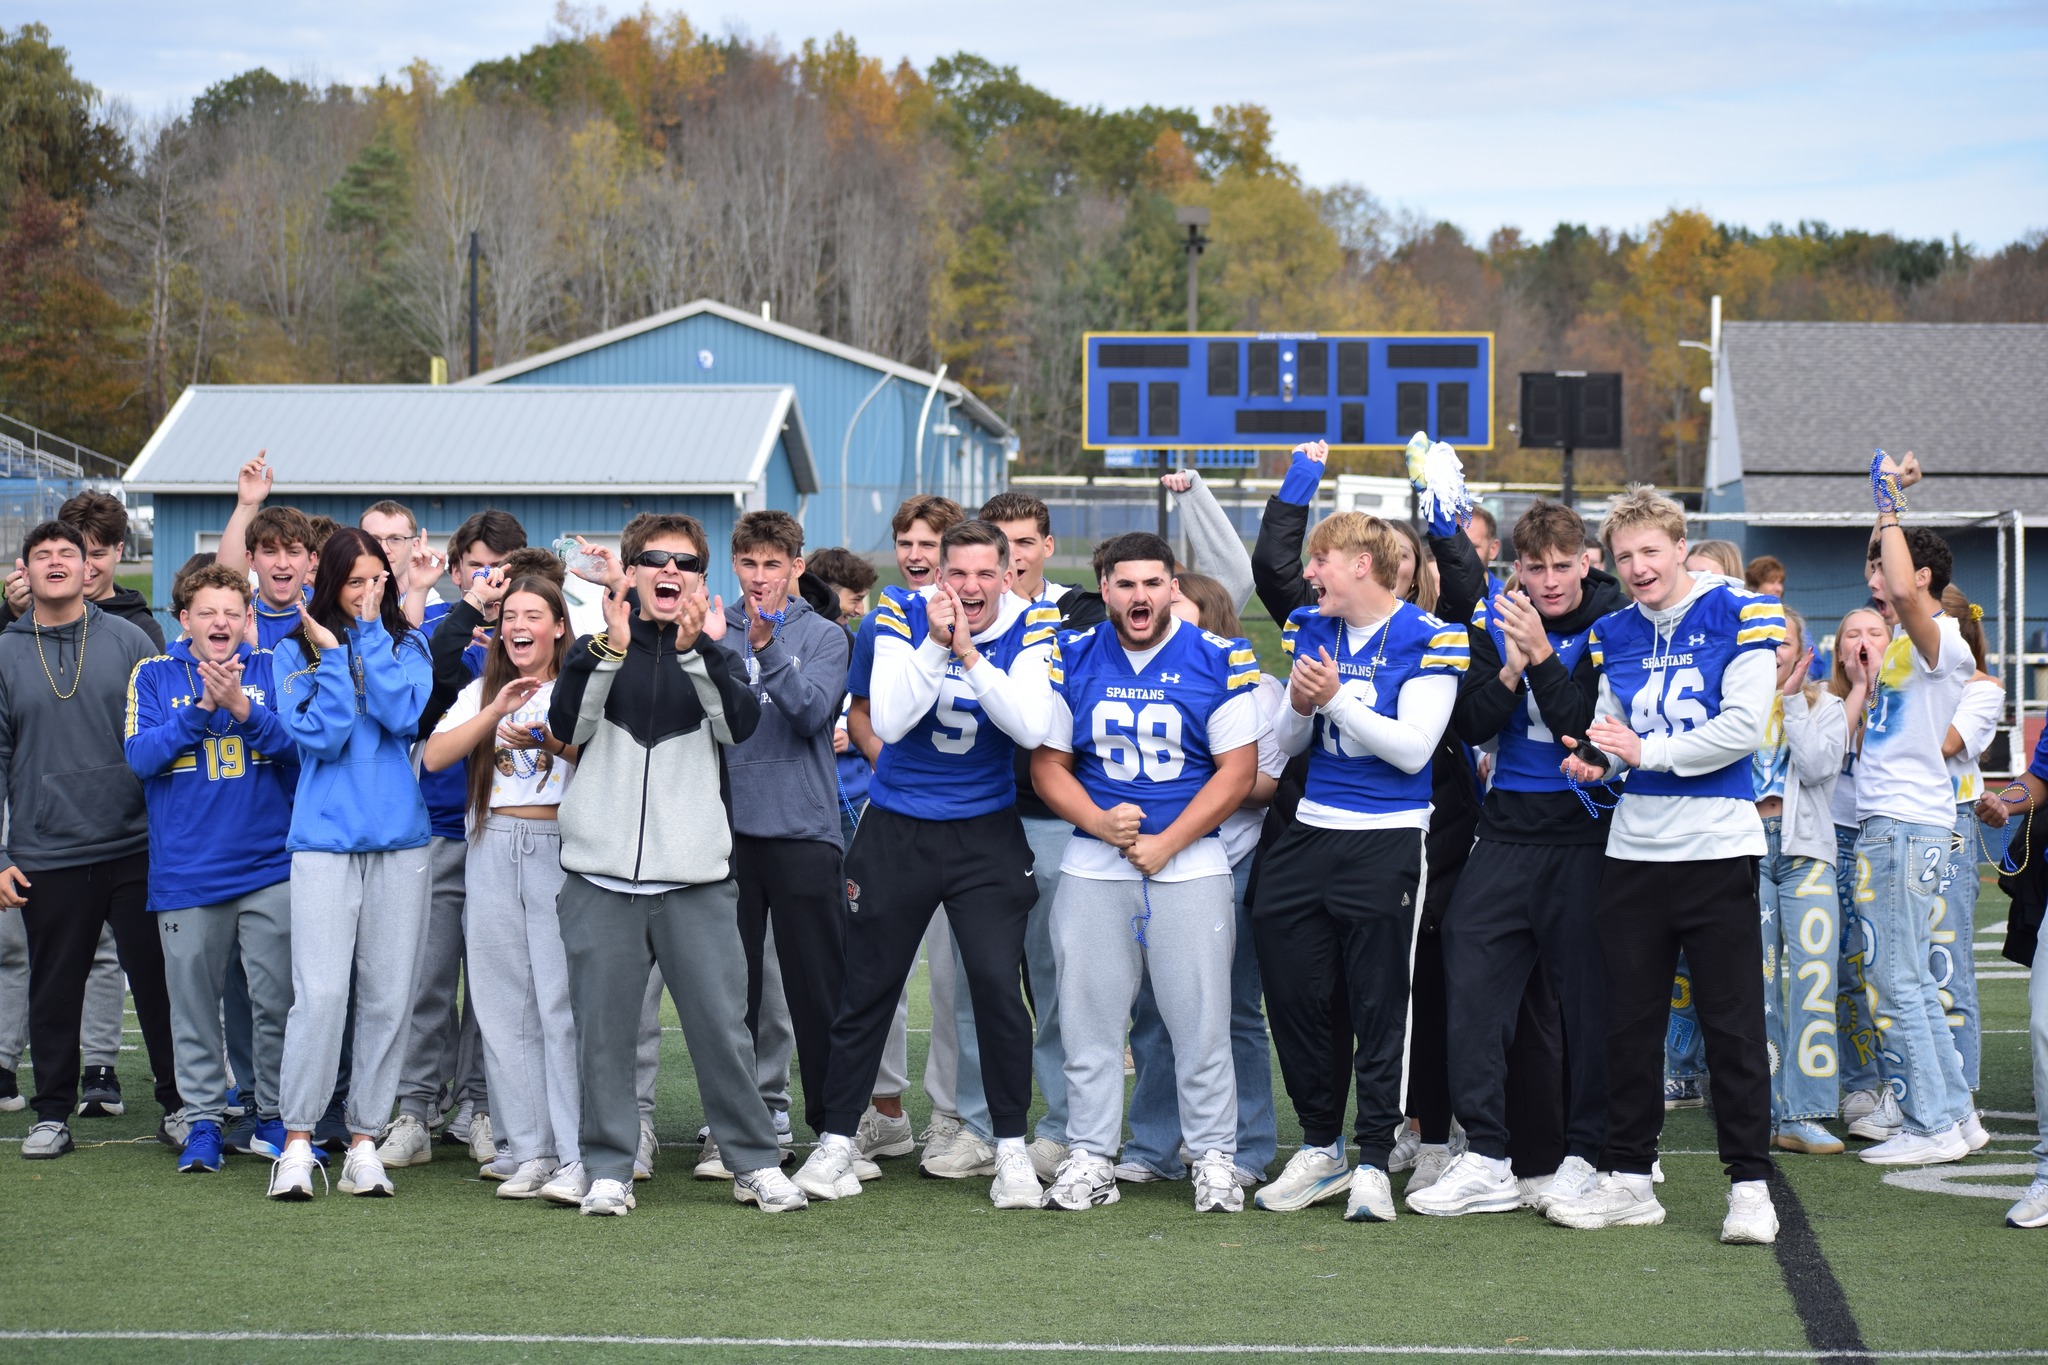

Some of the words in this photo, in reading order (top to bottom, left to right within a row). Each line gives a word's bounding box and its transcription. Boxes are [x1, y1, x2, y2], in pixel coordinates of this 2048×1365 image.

[1337, 662, 1372, 679] ARTANS
[1642, 653, 1694, 669] SPARTANS
[931, 677, 979, 755] 5
[1105, 686, 1165, 701] SPARTANS
[1631, 667, 1708, 741] 46
[203, 734, 246, 781] 19
[1092, 700, 1186, 783] 68
[1793, 856, 1838, 1078] 2026
